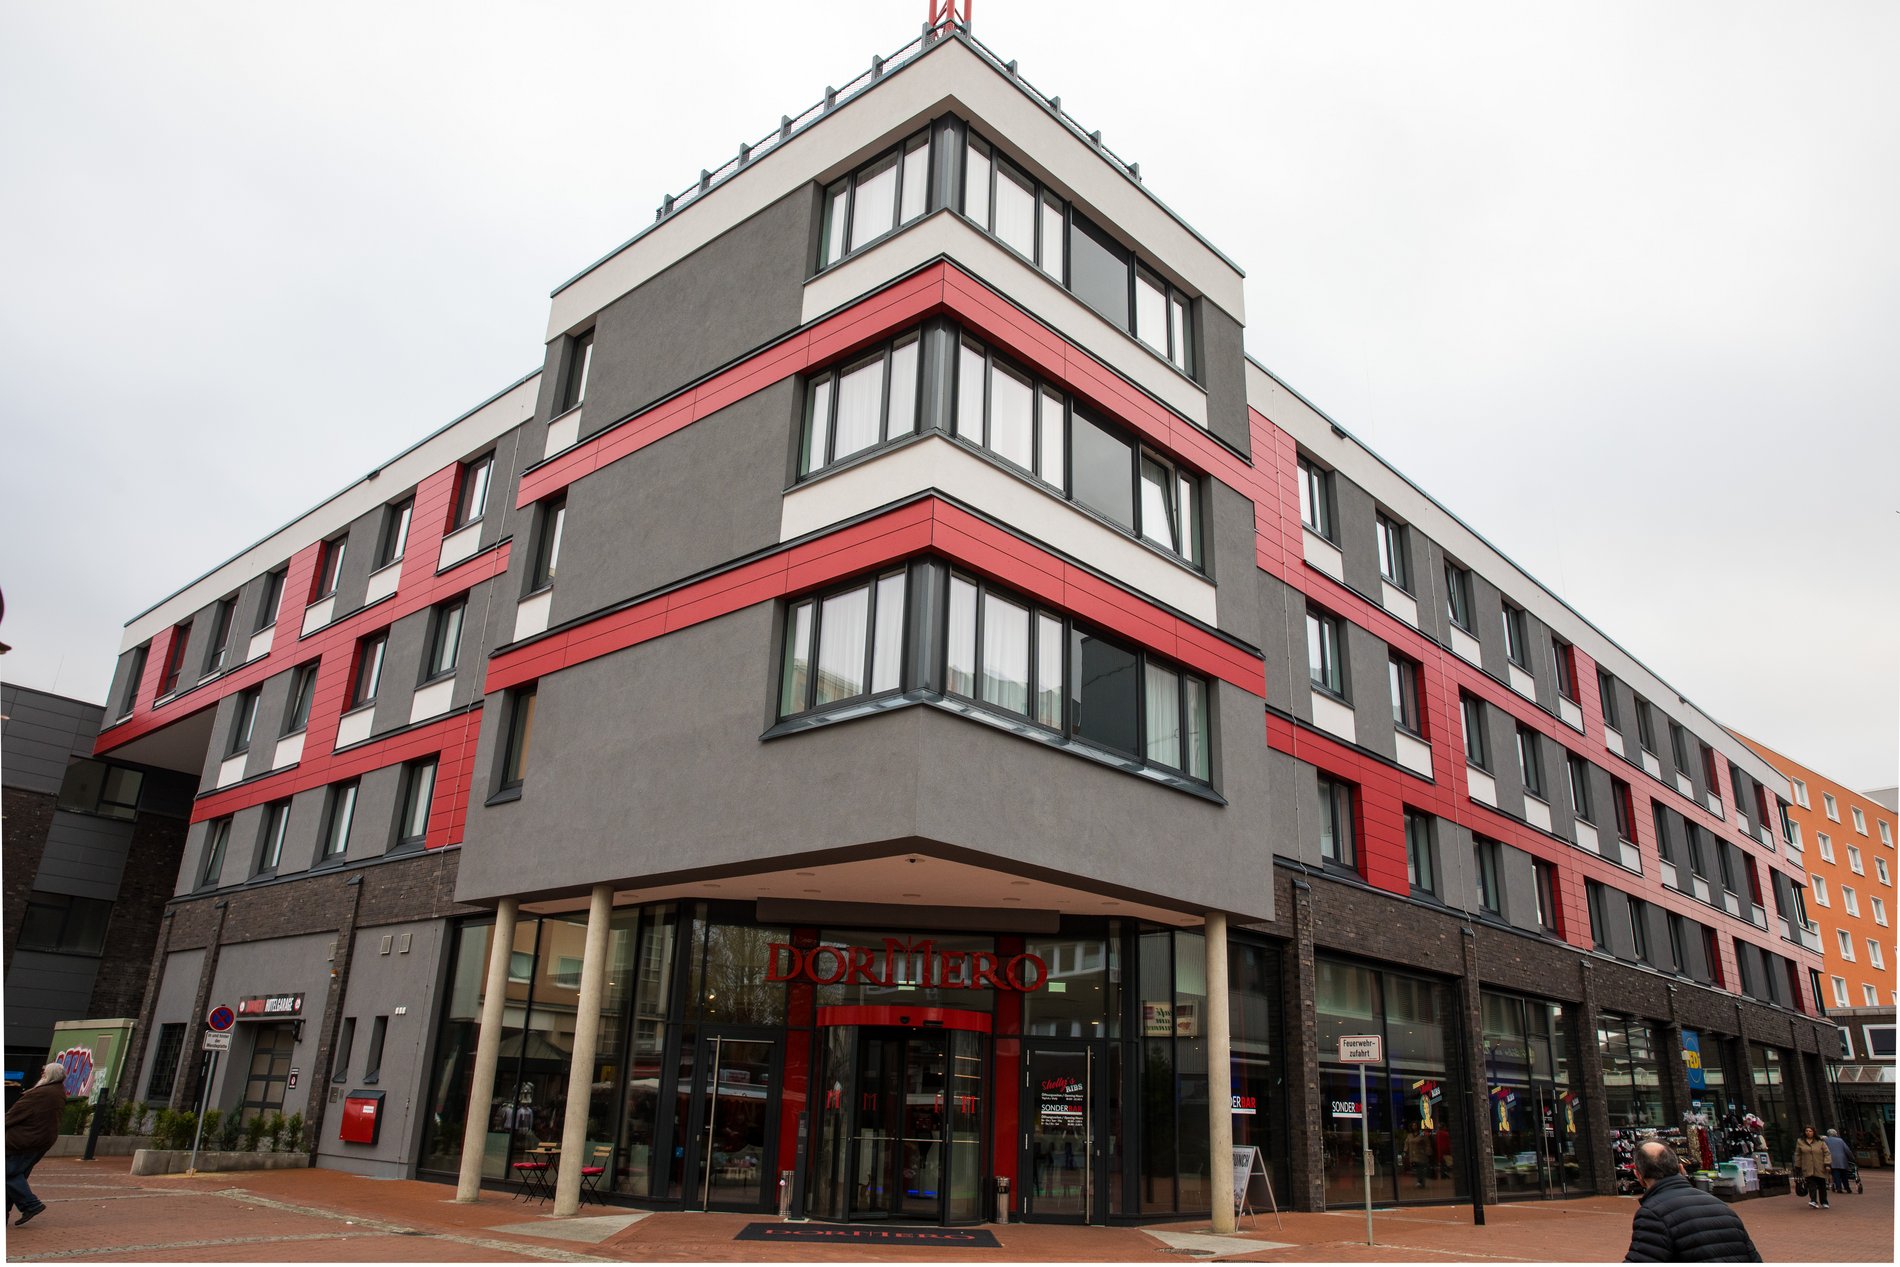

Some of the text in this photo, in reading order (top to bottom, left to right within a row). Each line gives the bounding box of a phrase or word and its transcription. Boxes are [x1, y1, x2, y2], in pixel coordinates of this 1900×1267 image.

[764, 936, 1048, 992] DORMERO
[1065, 1083, 1083, 1093] RIBS
[1230, 1095, 1257, 1108] ERBAR
[1331, 1101, 1362, 1113] SONDERBA
[1041, 1104, 1083, 1112] SONDERBAR
